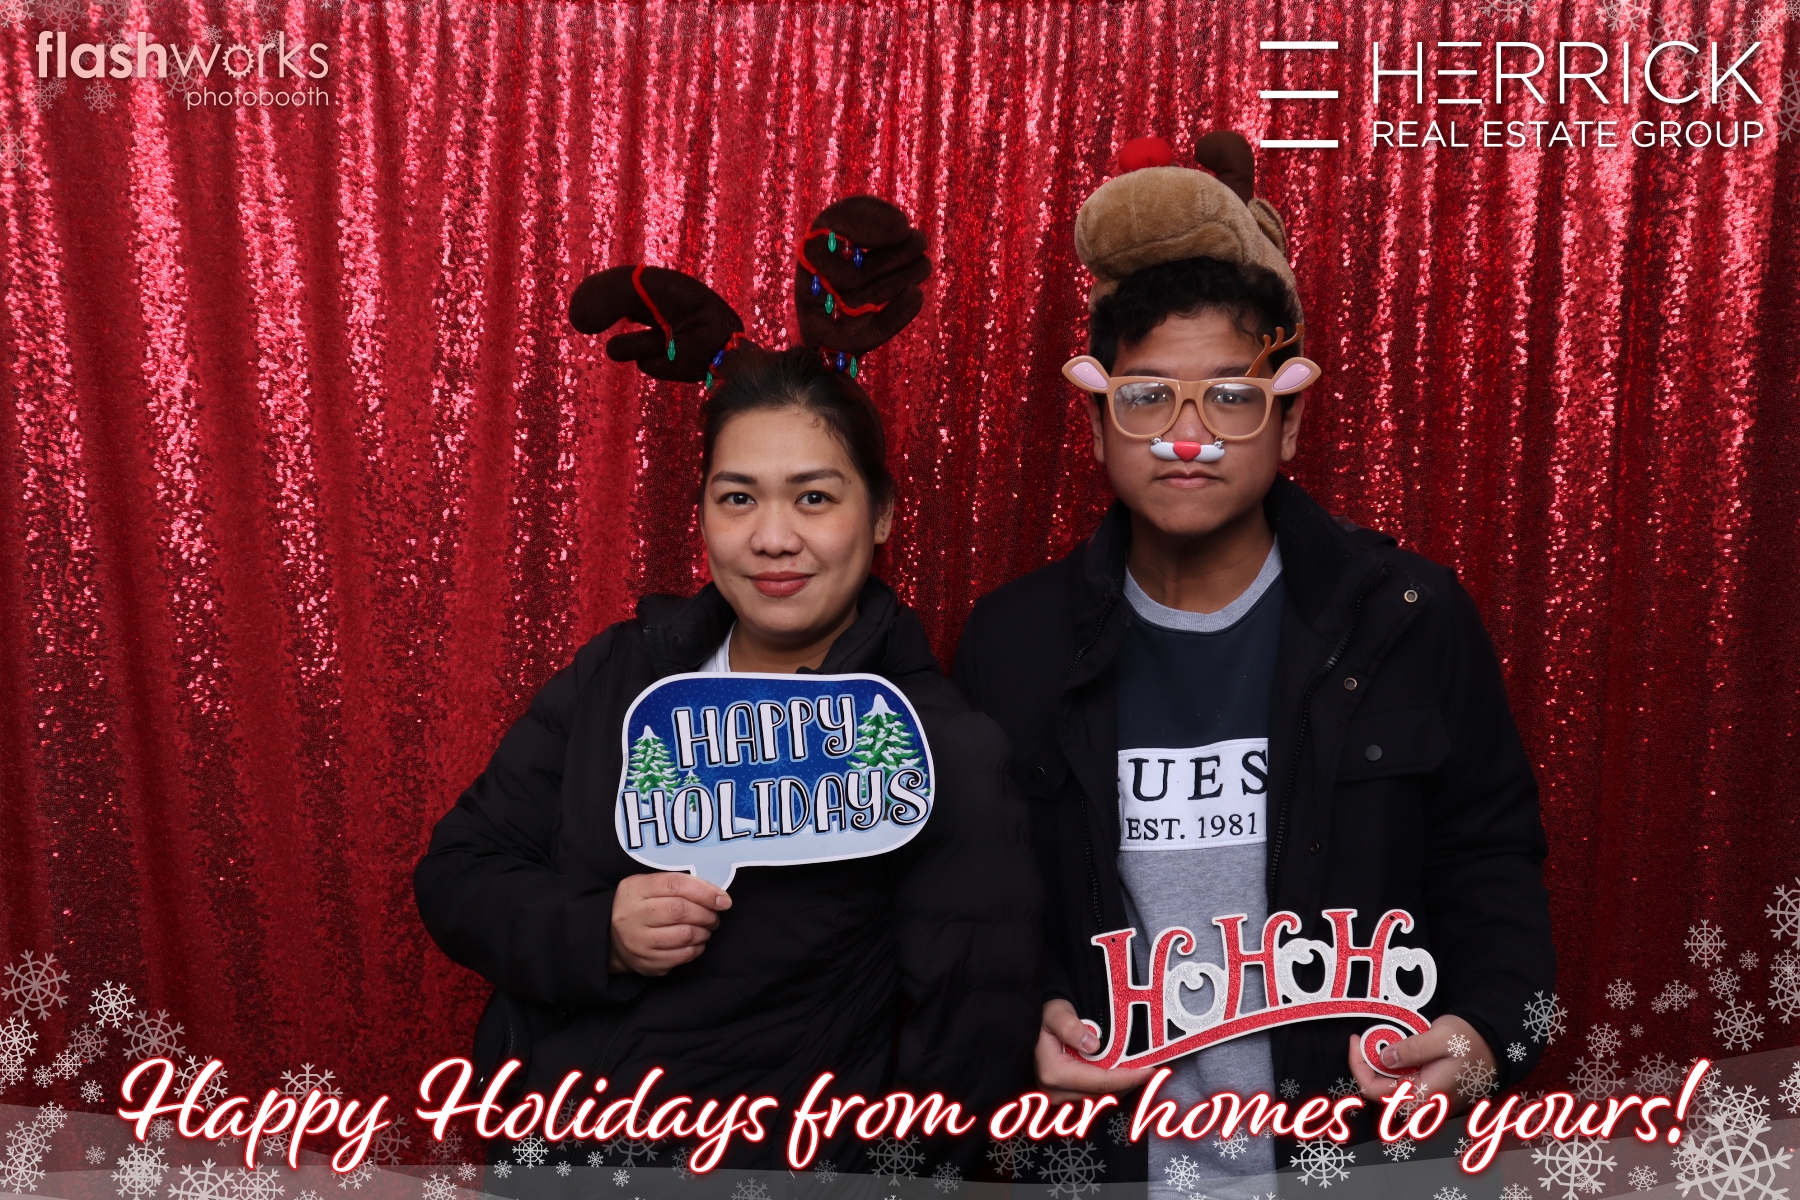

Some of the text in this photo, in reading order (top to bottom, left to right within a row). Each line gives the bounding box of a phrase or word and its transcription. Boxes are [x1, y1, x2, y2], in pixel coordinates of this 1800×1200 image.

[673, 695, 855, 769] HAPPY
[1117, 749, 1268, 802] UES
[622, 767, 930, 850] HOLIDAYS
[1125, 811, 1258, 841] EST. 1981
